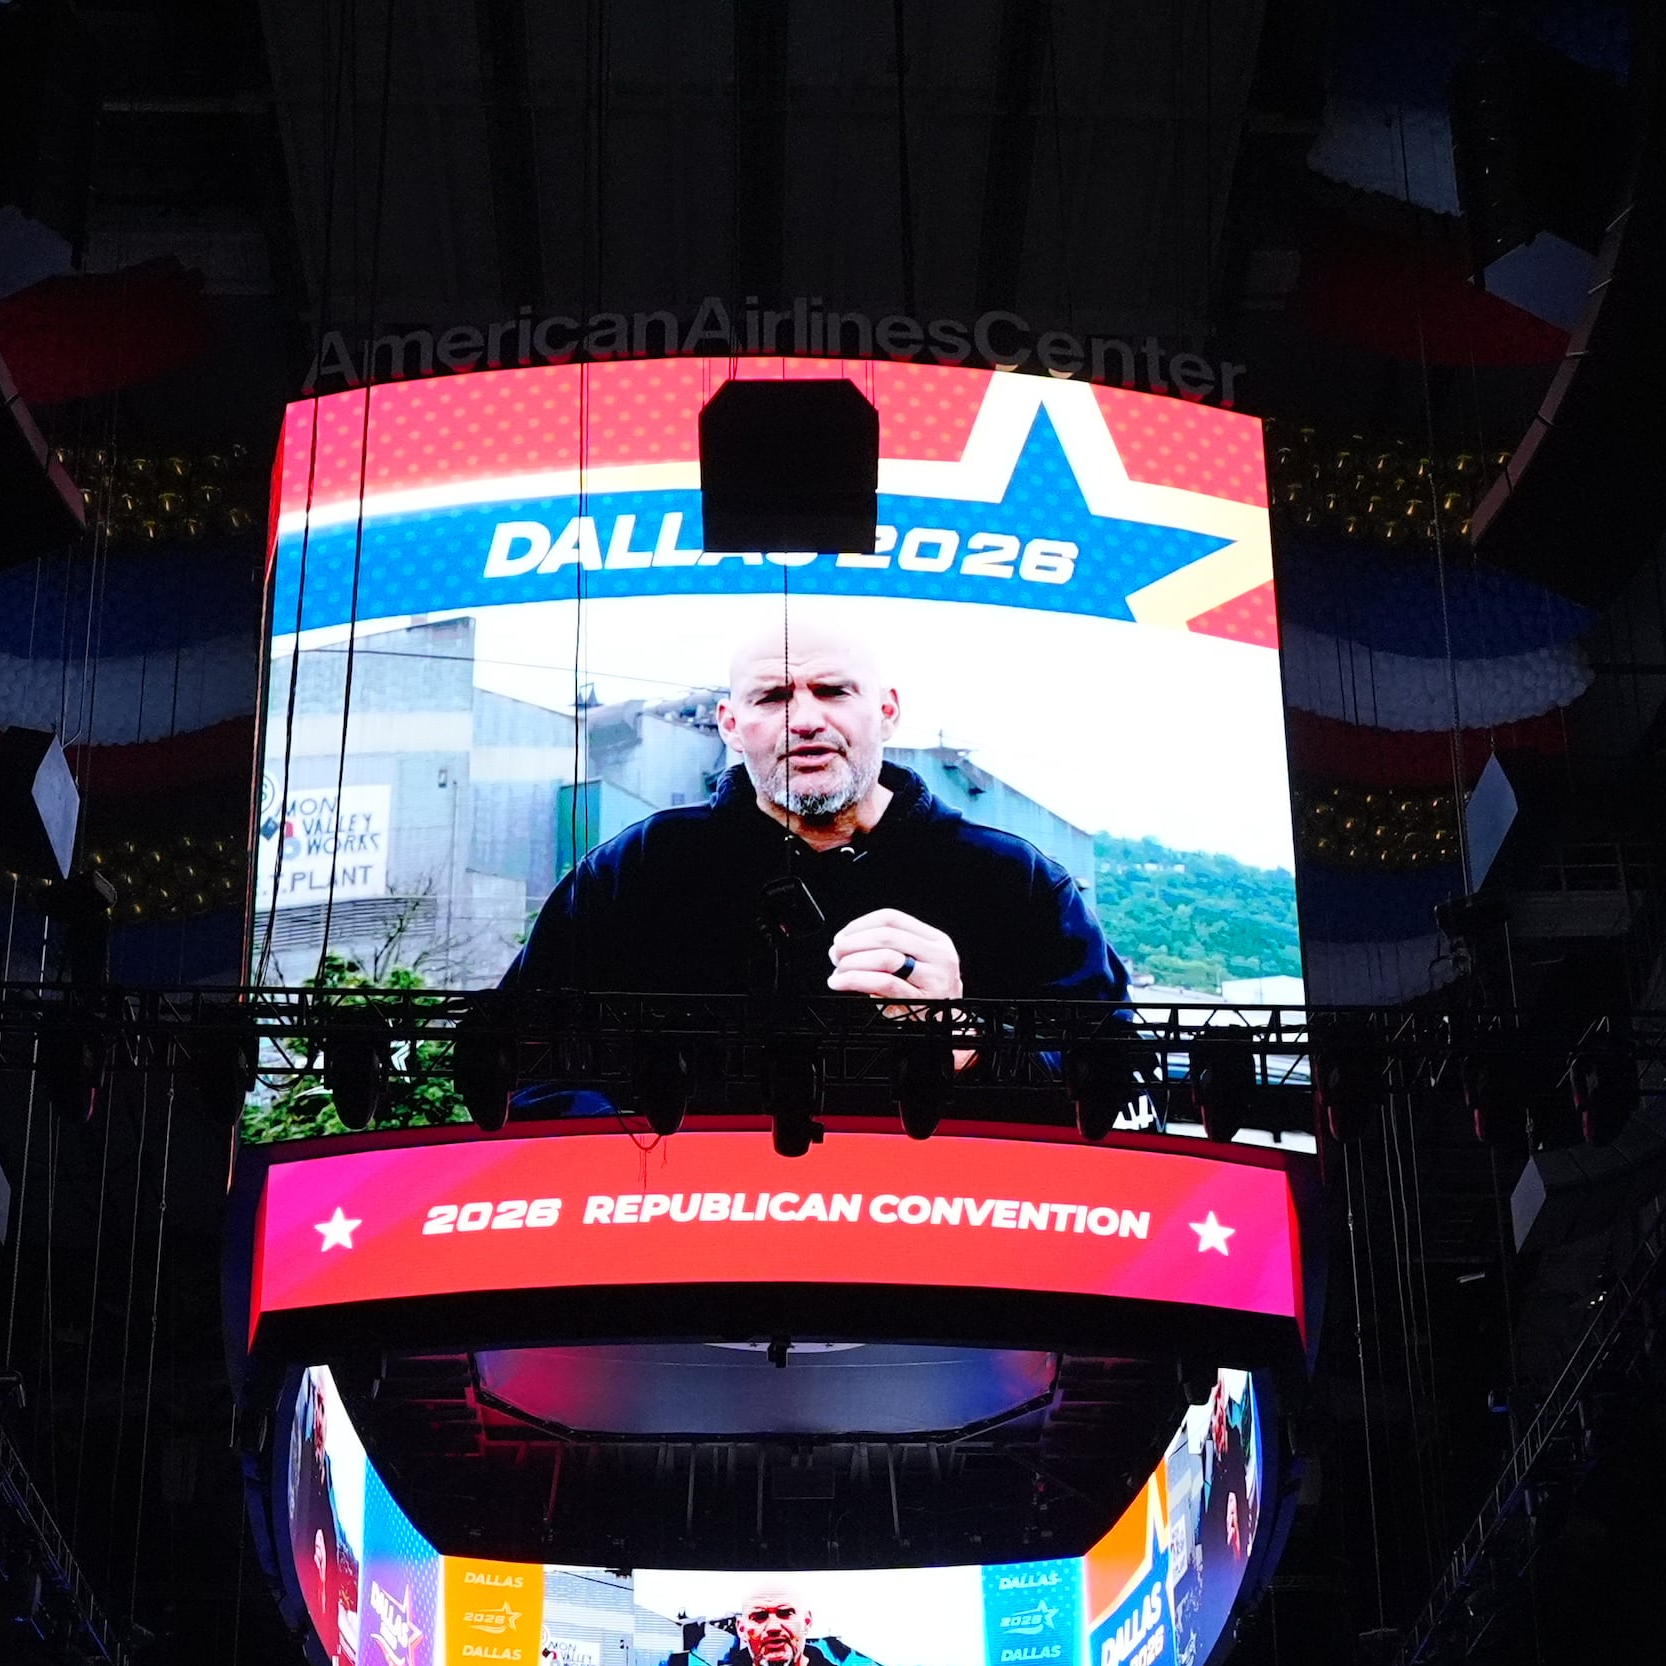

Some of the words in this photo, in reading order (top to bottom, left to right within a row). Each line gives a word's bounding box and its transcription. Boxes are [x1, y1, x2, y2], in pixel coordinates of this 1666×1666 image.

[302, 813, 372, 835] VALLEY
[422, 1204, 562, 1236] 2026
[582, 1191, 862, 1227] REPUBLICAN
[869, 1194, 1151, 1240] CONVENTION
[464, 1572, 524, 1588] DALLAS
[998, 1573, 1060, 1590] DALLAS
[462, 1645, 521, 1660] DALLAS
[1001, 1645, 1061, 1662] DALLAS
